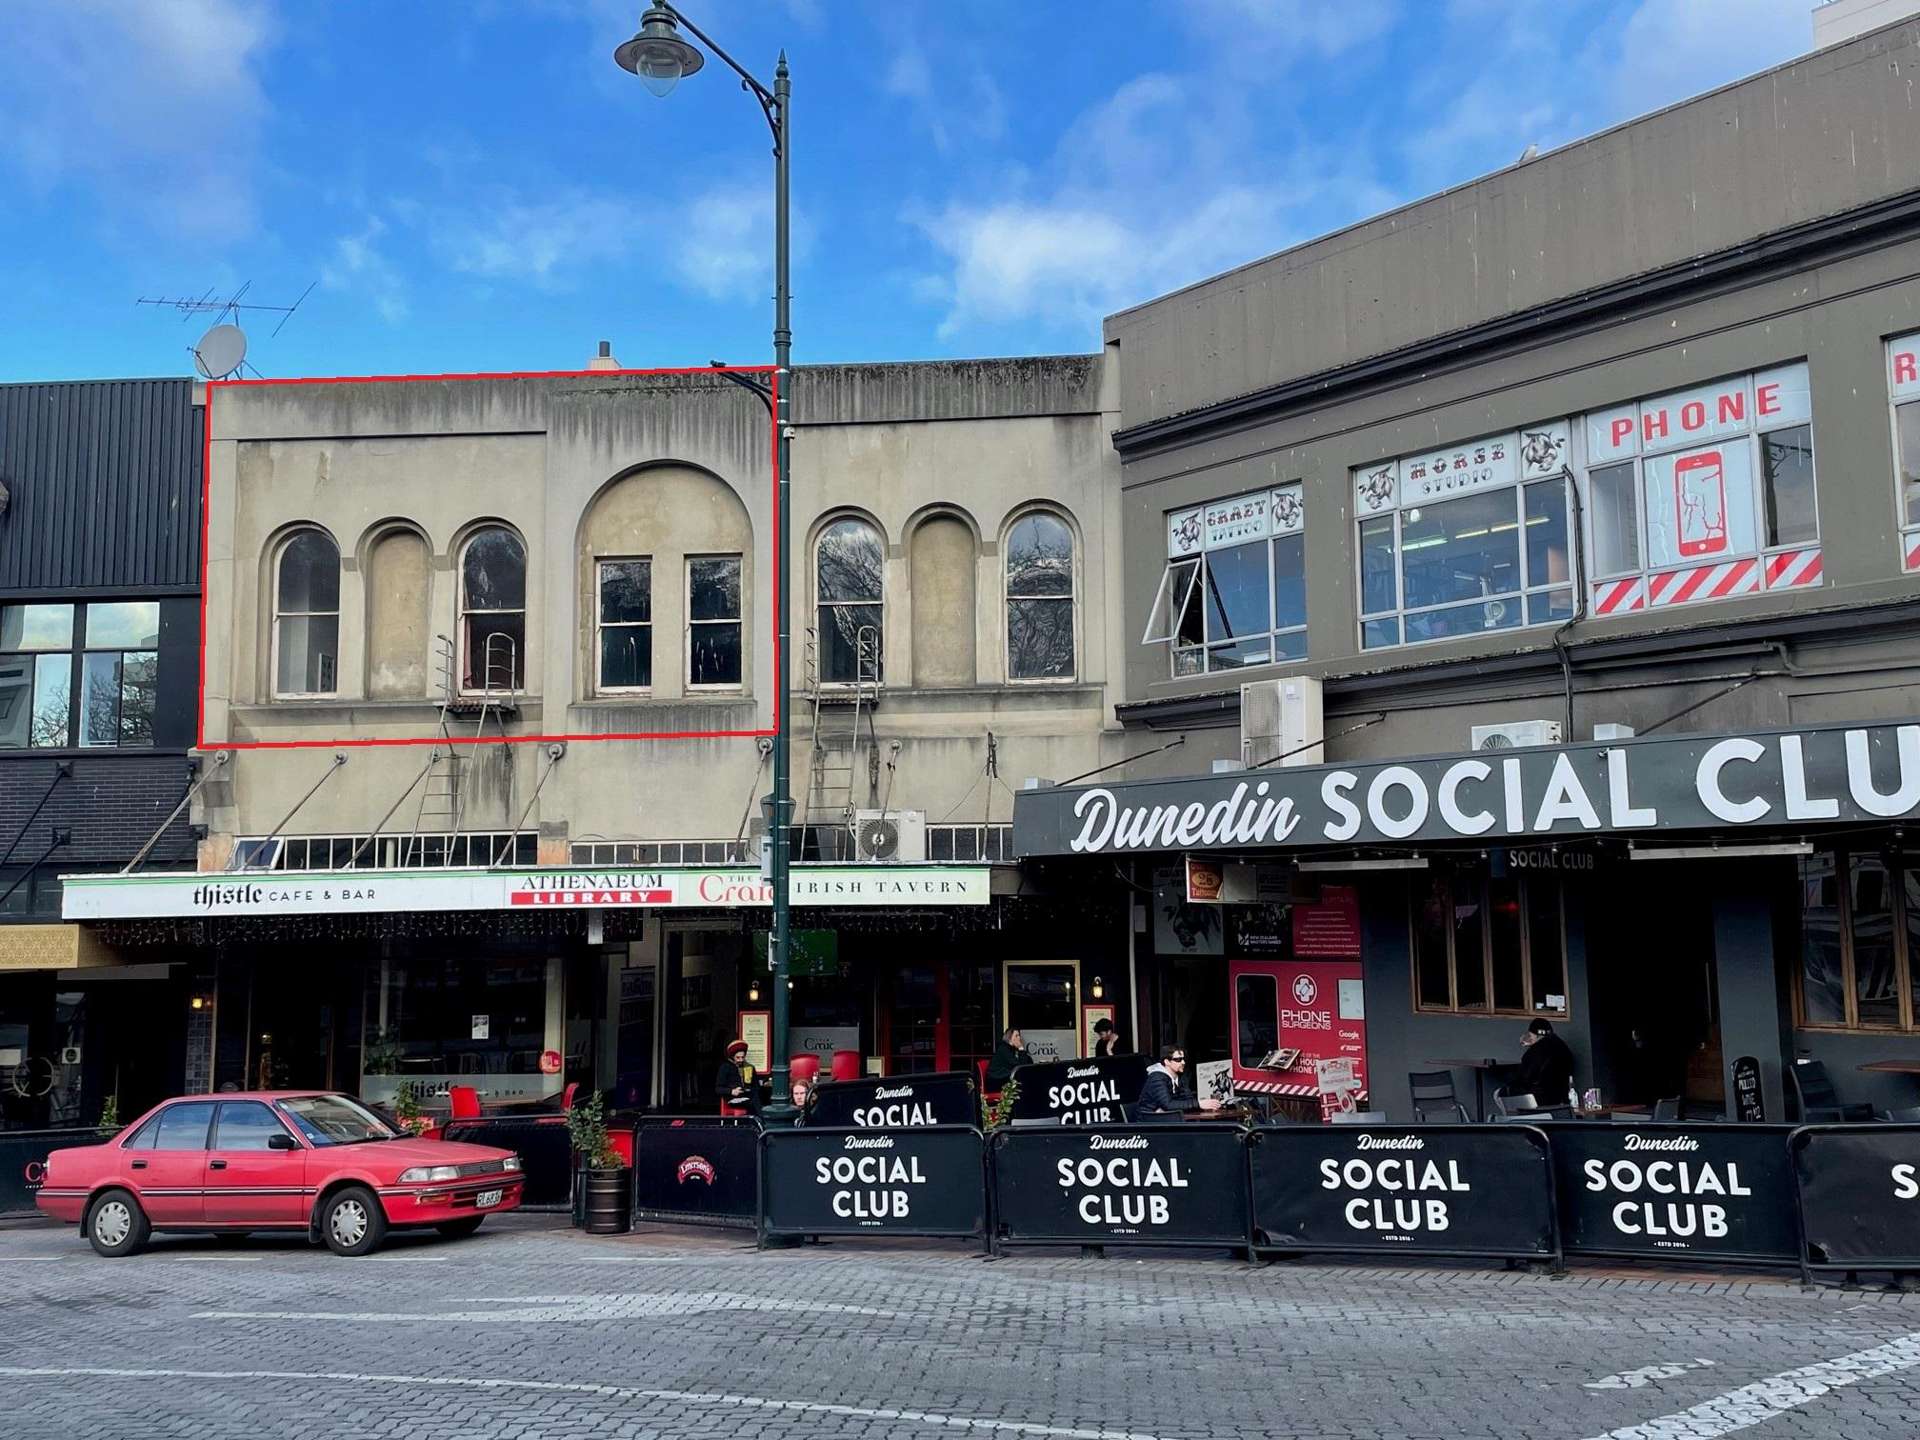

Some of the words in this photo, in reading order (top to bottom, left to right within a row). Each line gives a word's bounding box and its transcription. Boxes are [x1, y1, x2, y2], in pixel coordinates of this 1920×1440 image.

[1611, 383, 1782, 448] PHONE
[1410, 442, 1504, 480] HORSE
[1422, 468, 1492, 495] STUDIO
[1211, 520, 1263, 542] TATTOO
[1070, 781, 1301, 853] Dunedin
[1321, 748, 1659, 841] SOCIAL
[1509, 849, 1559, 868] SOCIAL
[1562, 852, 1594, 870] CLUB
[521, 874, 663, 891] ATHENAEUM
[796, 881, 862, 894] IRISH
[875, 881, 968, 894] TAVERN
[193, 883, 262, 910] thistle
[269, 890, 313, 902] CAFE
[323, 890, 332, 900] &
[342, 889, 376, 900] BAR
[533, 891, 651, 904] LIBRARY
[1281, 1009, 1331, 1023] PHONE
[1281, 1020, 1332, 1031] SURGEONS
[1338, 1030, 1360, 1040] Google
[1067, 1064, 1099, 1079] Dunedin
[875, 1085, 913, 1100] Dunedin
[1049, 1080, 1121, 1108] SOCIAL
[853, 1101, 938, 1127] SOCIAL
[844, 1135, 894, 1149] Dunedin
[1089, 1134, 1149, 1150] Dunedin
[1357, 1134, 1424, 1150] Dunedin
[1624, 1134, 1699, 1151] Dunedin
[815, 1156, 926, 1184] SOCIAL
[1057, 1158, 1188, 1187] SOCIAL
[1320, 1158, 1470, 1191] SOCIAL
[1583, 1159, 1751, 1196] SOCIAL
[832, 1190, 910, 1218] CLUB
[1079, 1194, 1170, 1224] CLUB
[1345, 1198, 1449, 1231] CLUB
[1612, 1201, 1729, 1238] CLUB
